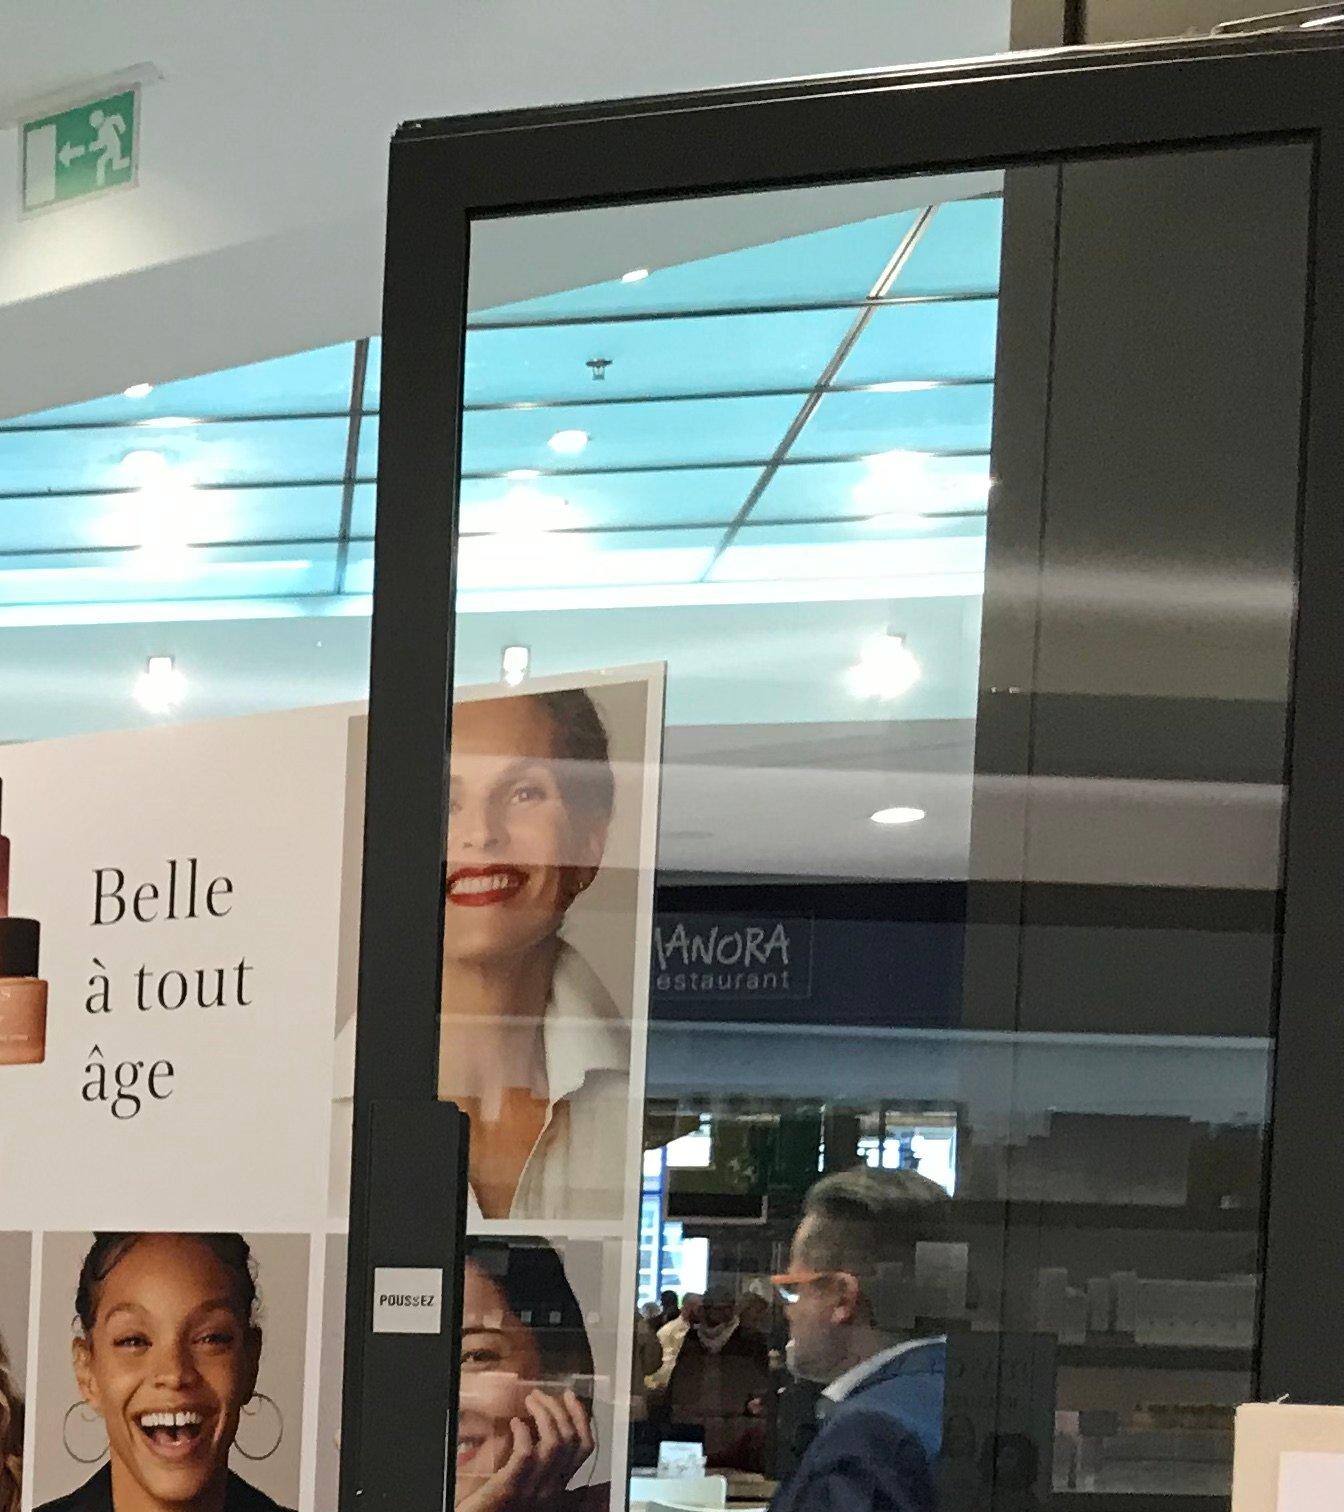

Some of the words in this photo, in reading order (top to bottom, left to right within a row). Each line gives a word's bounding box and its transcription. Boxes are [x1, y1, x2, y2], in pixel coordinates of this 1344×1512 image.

[90, 857, 234, 926] Belle
[654, 923, 790, 970] ANORA
[85, 957, 112, 1015] à
[134, 956, 255, 1012] tout
[656, 971, 790, 991] estaurant
[81, 1044, 176, 1120] âge
[379, 1294, 435, 1307] POUSSEZ
